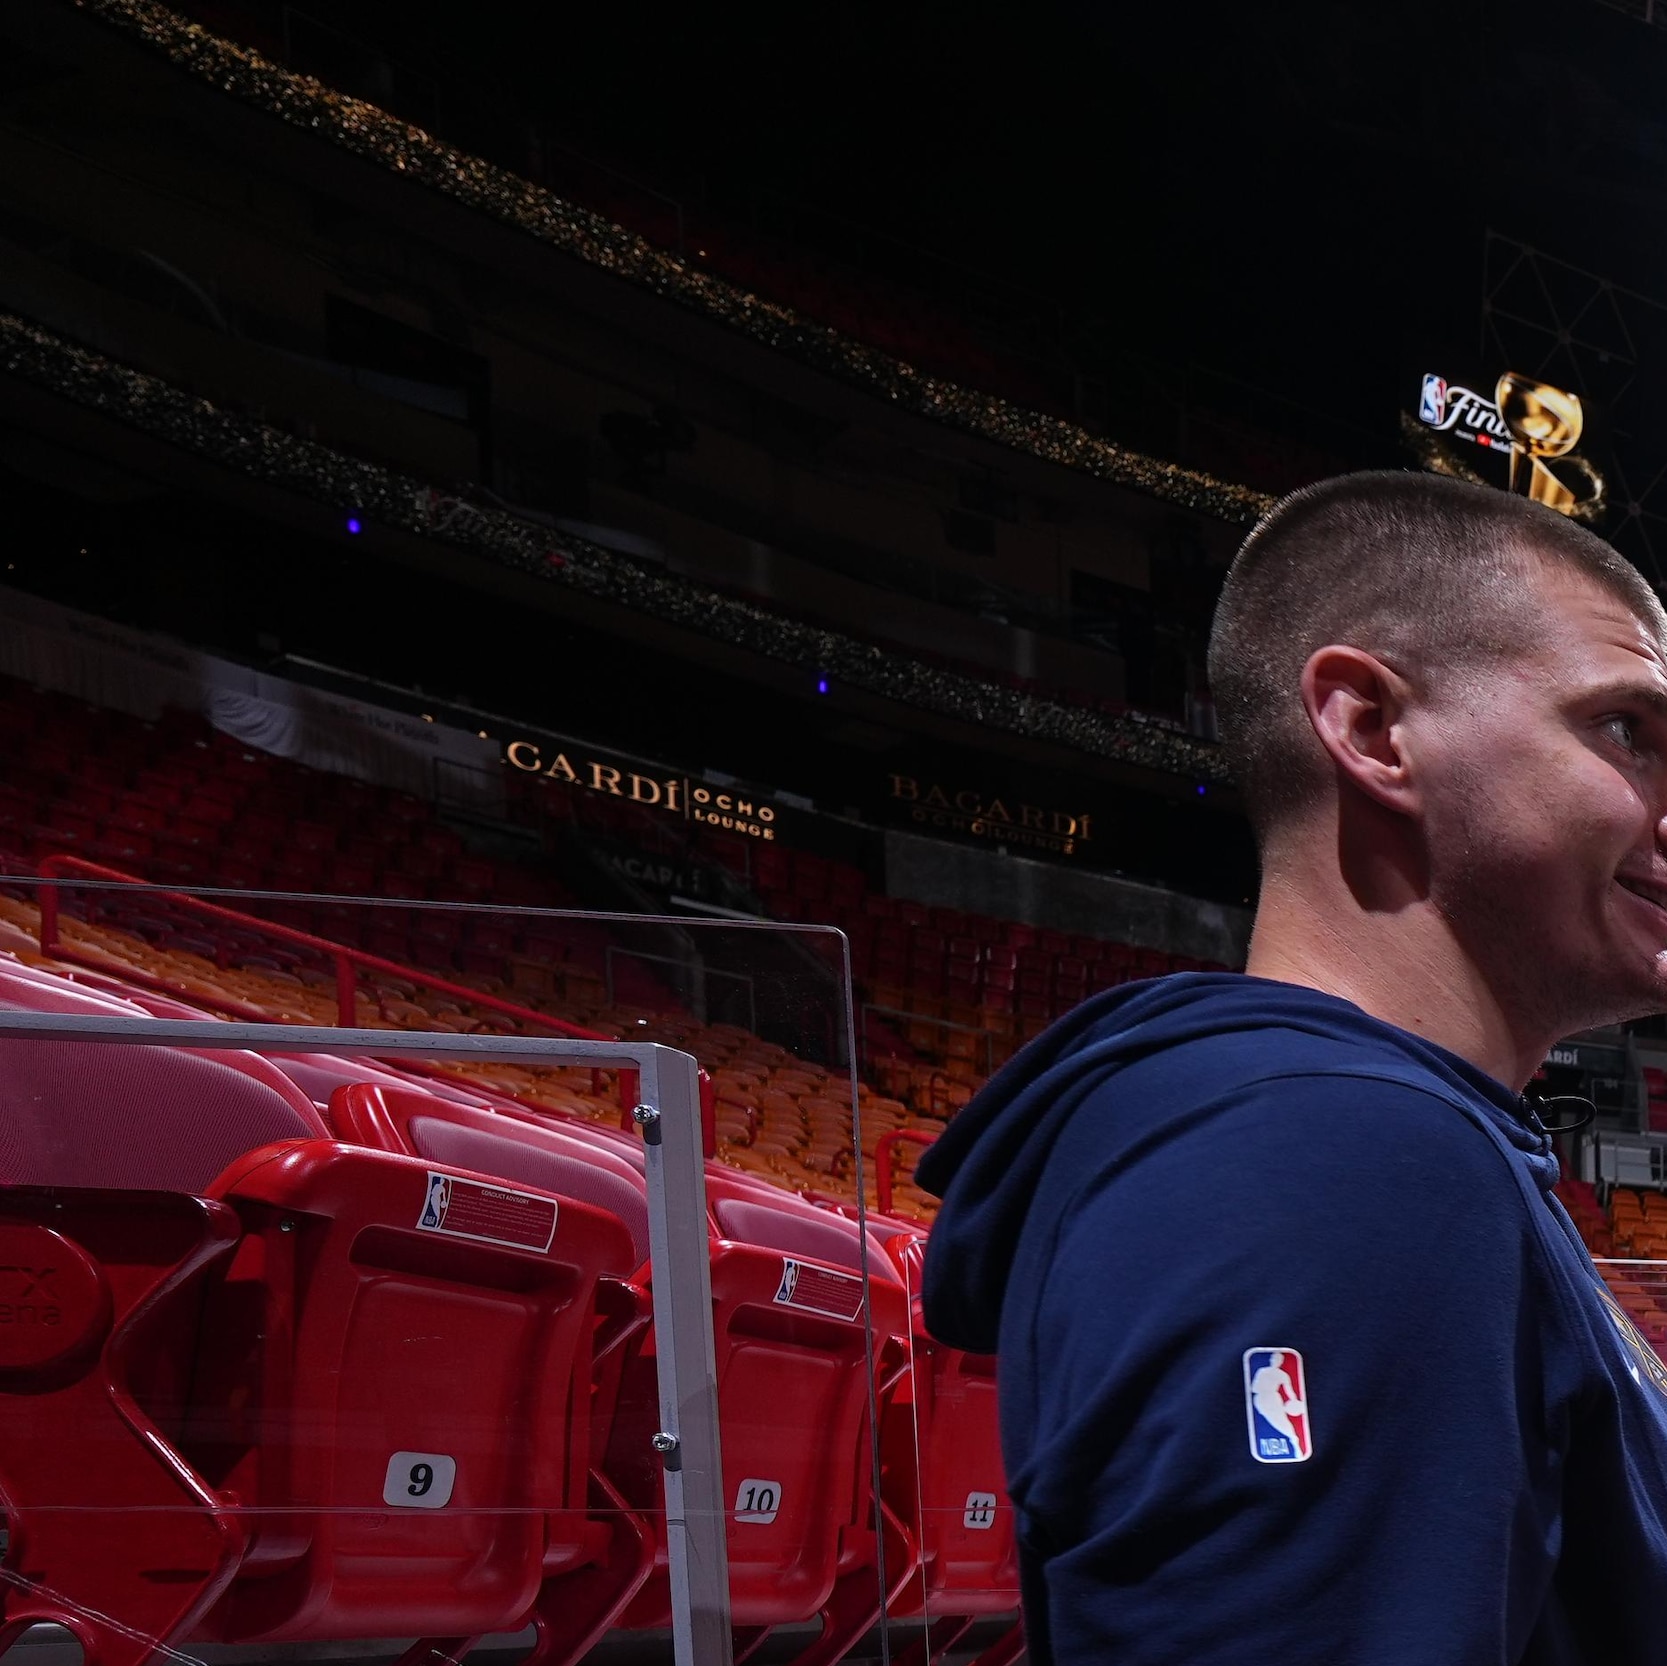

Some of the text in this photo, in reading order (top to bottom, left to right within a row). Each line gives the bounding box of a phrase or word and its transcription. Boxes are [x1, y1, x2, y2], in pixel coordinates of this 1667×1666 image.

[693, 787, 776, 822] OCHO
[694, 808, 776, 841] LOUNGE
[407, 1463, 433, 1497] 9
[744, 1487, 775, 1513] 10
[968, 1500, 990, 1522] 11
